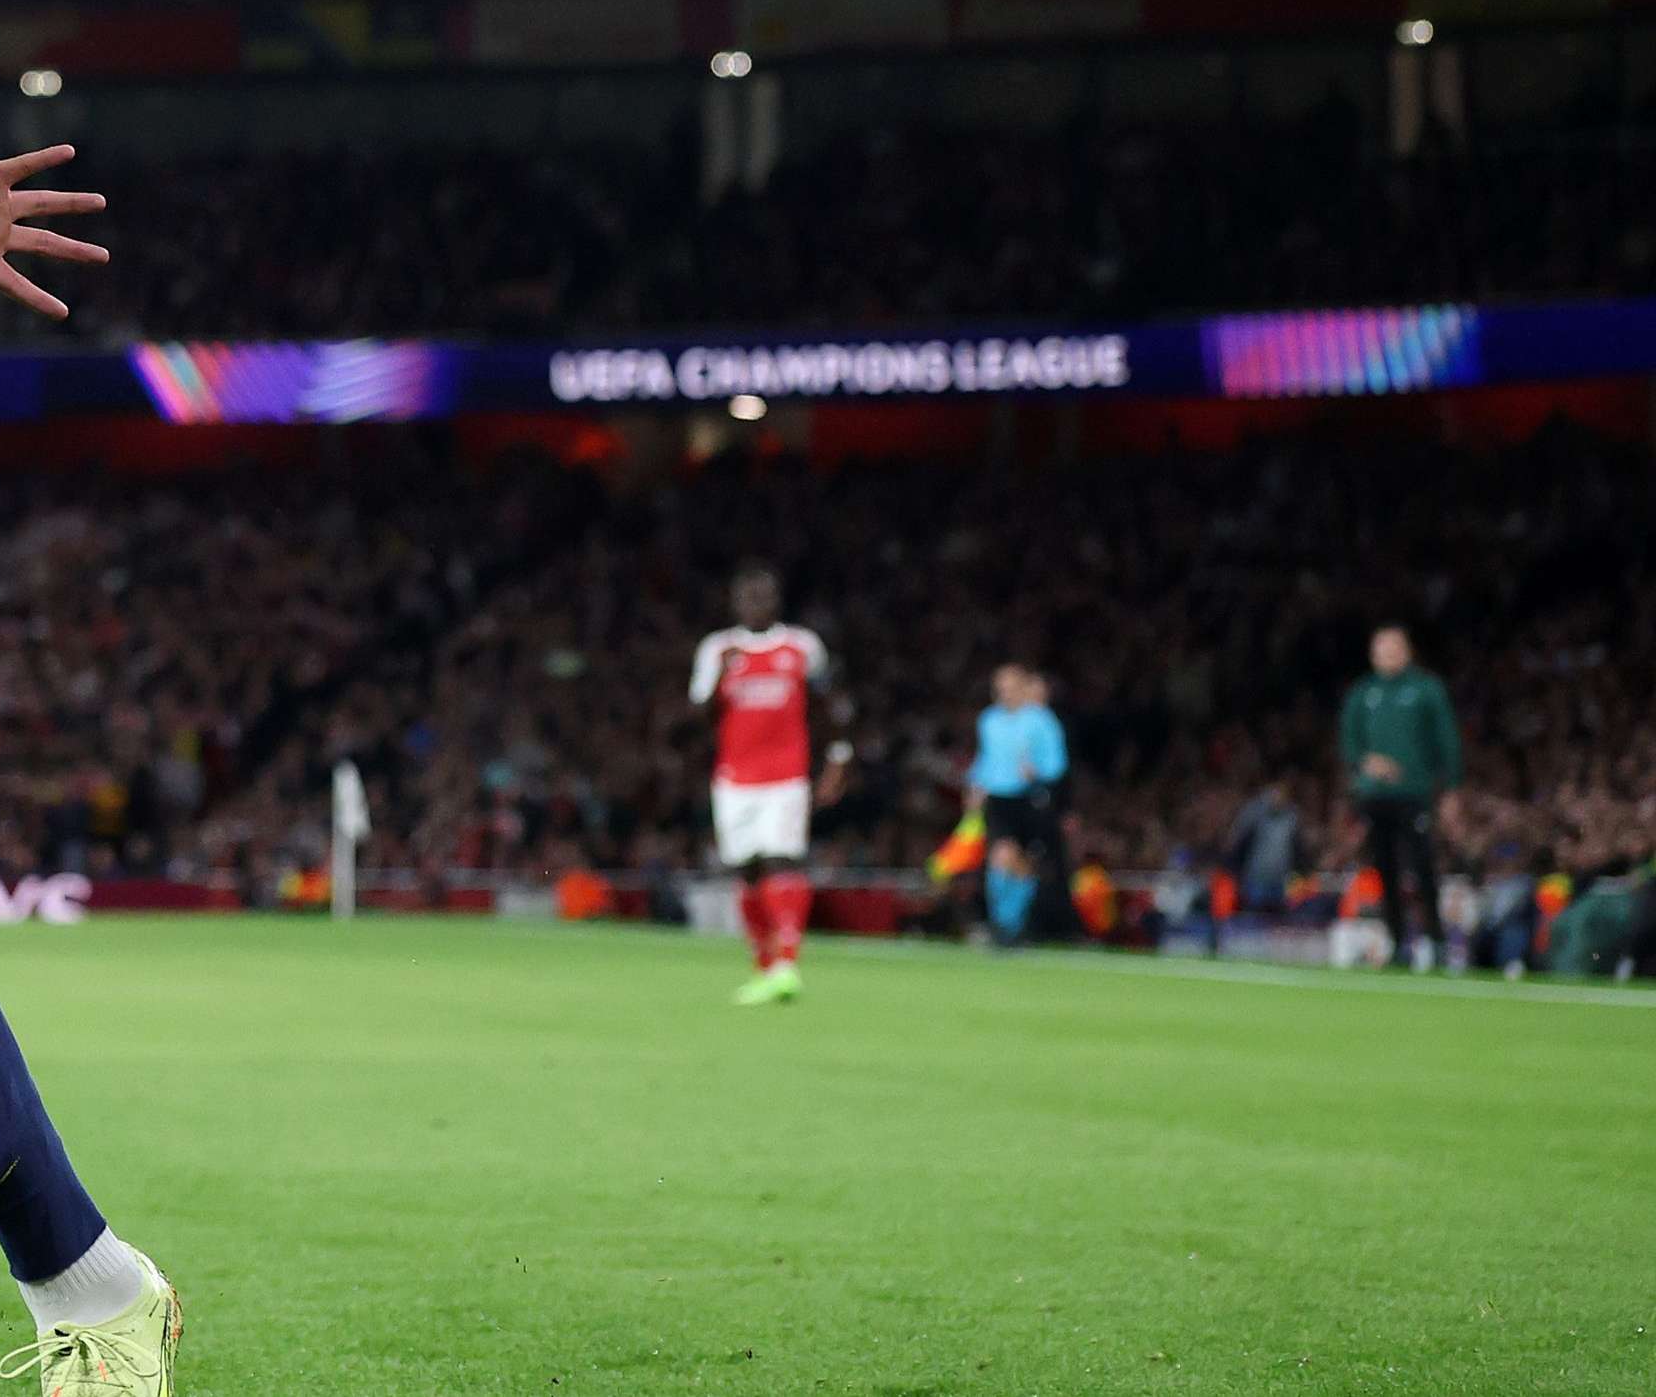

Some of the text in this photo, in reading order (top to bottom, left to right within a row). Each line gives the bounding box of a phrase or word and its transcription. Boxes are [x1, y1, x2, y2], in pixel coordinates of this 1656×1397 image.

[549, 334, 1130, 402] UEFA CHAMPIONS LEAGUE
